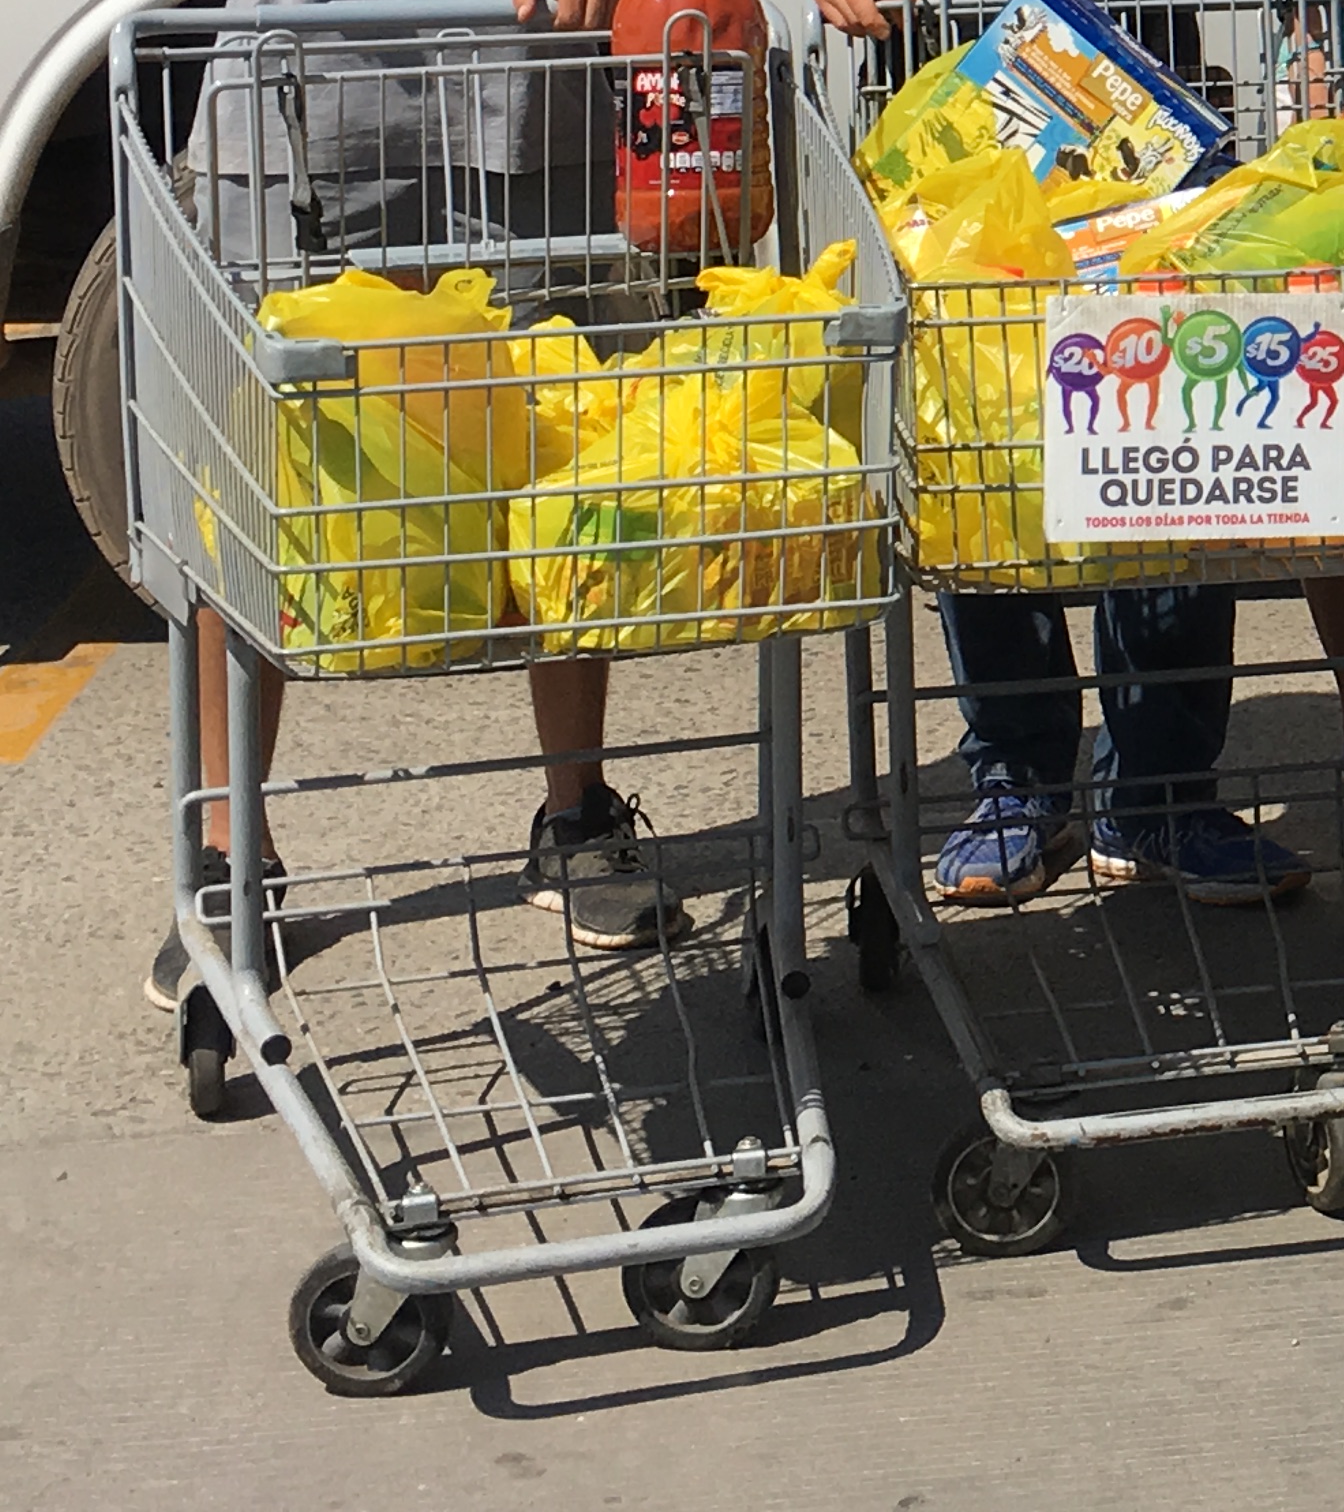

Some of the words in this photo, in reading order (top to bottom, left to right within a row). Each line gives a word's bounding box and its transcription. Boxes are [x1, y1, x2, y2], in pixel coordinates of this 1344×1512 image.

[1092, 59, 1144, 110] Pepe
[1096, 209, 1155, 232] Pepe
[1112, 332, 1162, 369] $10
[1186, 325, 1230, 364] $5
[1246, 332, 1291, 366] $15
[1081, 438, 1199, 475] LLEGÓ
[1212, 444, 1311, 472] PARA
[1100, 476, 1299, 507] QUEDARSE
[1086, 516, 1126, 528] TODOS
[1129, 516, 1152, 527] LOS
[1155, 512, 1184, 526] DÍAS
[1188, 515, 1211, 525] POR
[1215, 514, 1247, 524] TODA
[1250, 514, 1264, 524] LA
[1267, 512, 1310, 524] TIENDA
